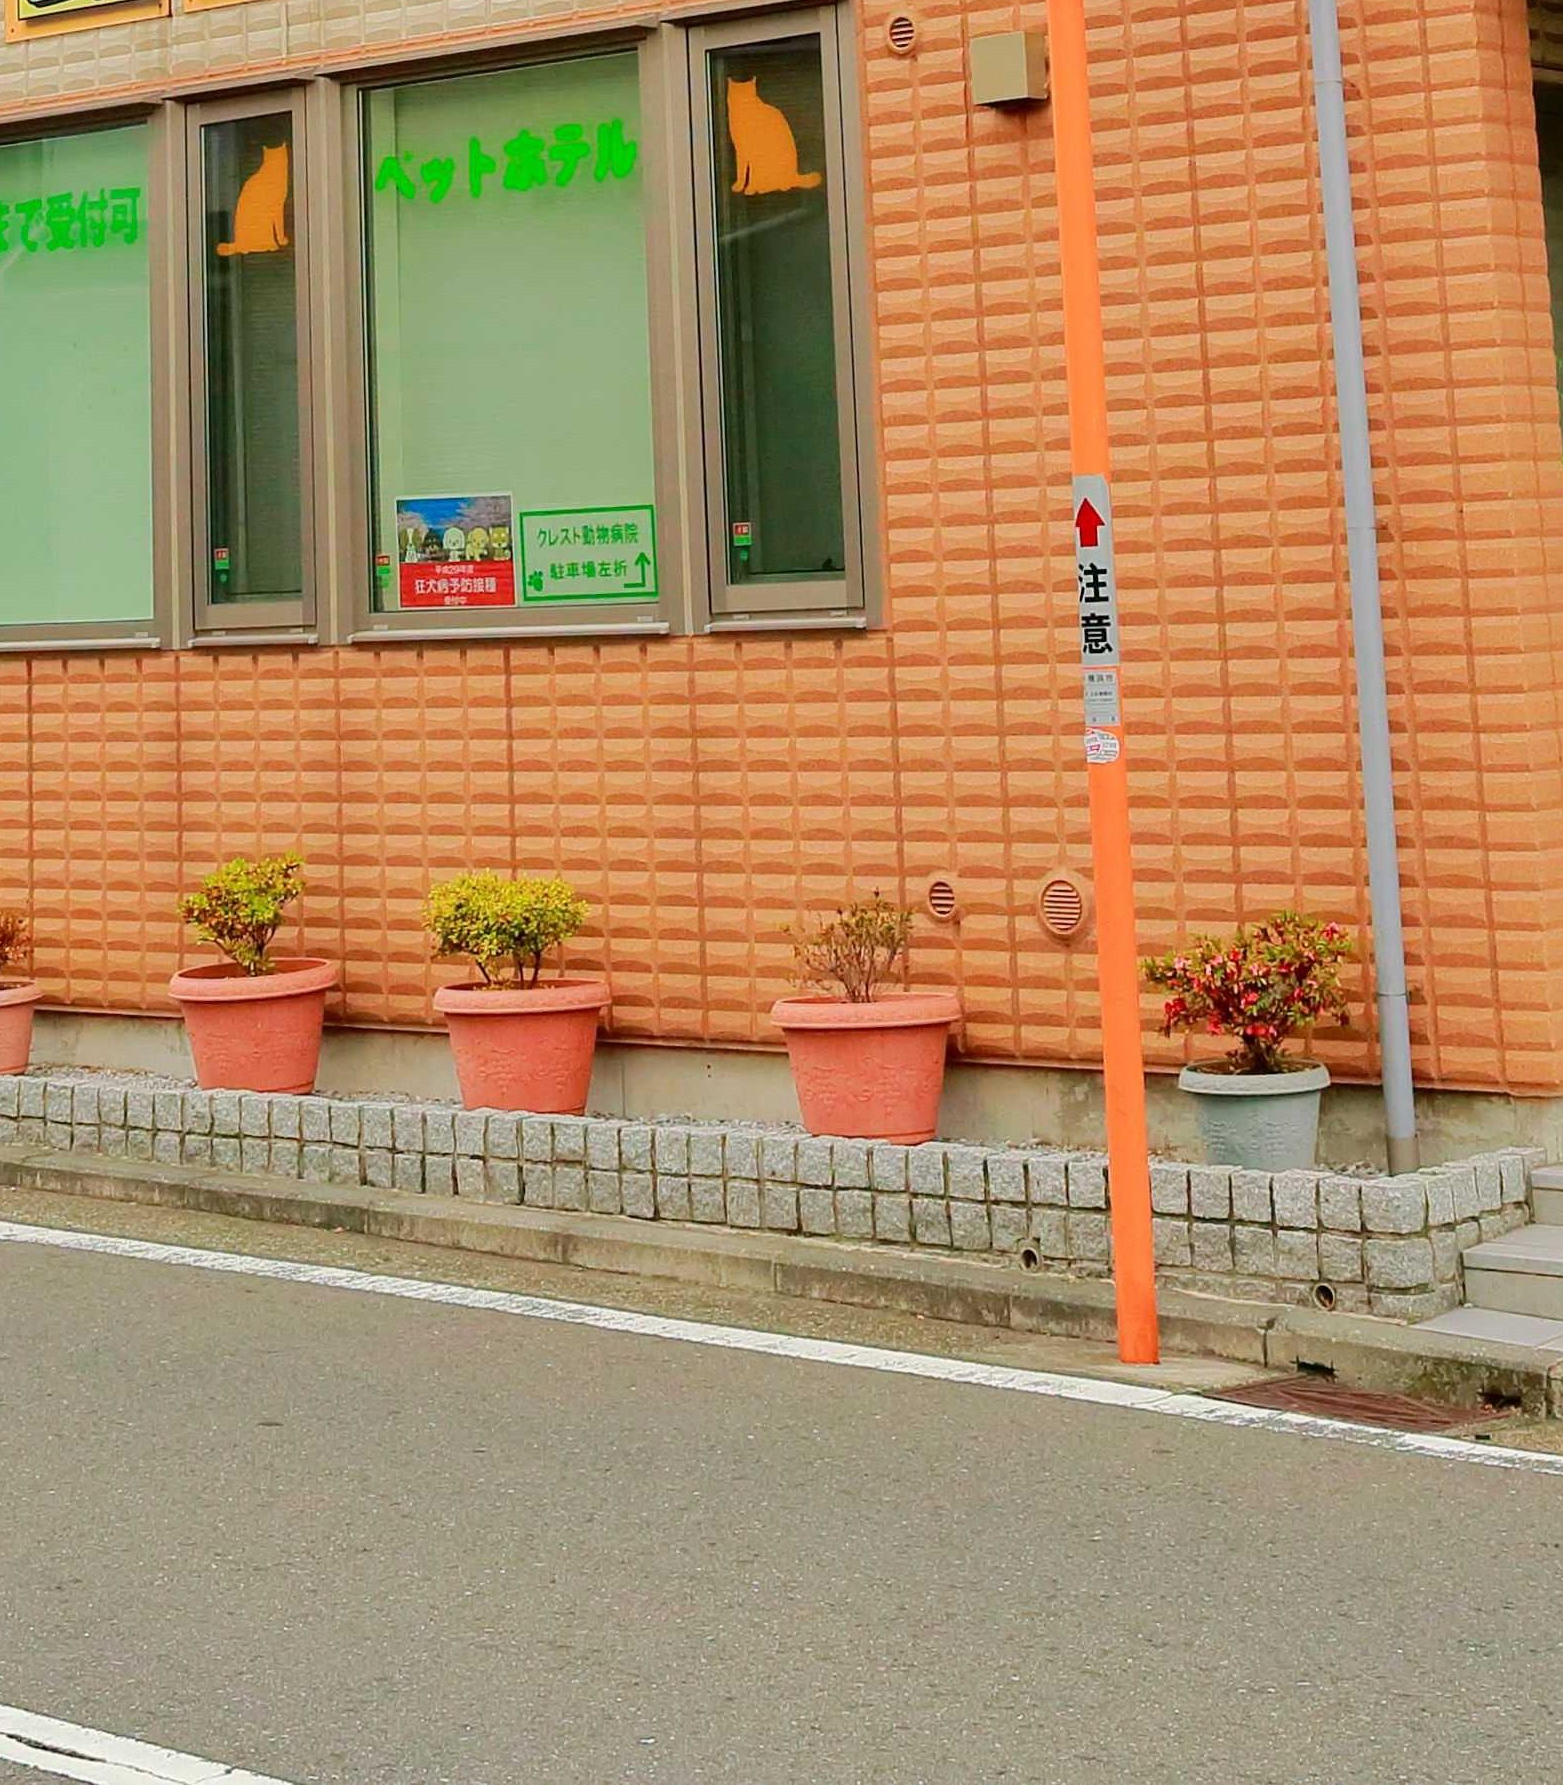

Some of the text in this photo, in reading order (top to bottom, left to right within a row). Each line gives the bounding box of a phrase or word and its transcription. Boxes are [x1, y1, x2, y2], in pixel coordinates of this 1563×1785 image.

[374, 118, 638, 203] ペットホテル
[536, 522, 640, 549] クレスト動物病院
[549, 559, 629, 581] 駐車場左折
[414, 577, 497, 595] 狂犬病予防接種
[1078, 562, 1114, 656] 注意
